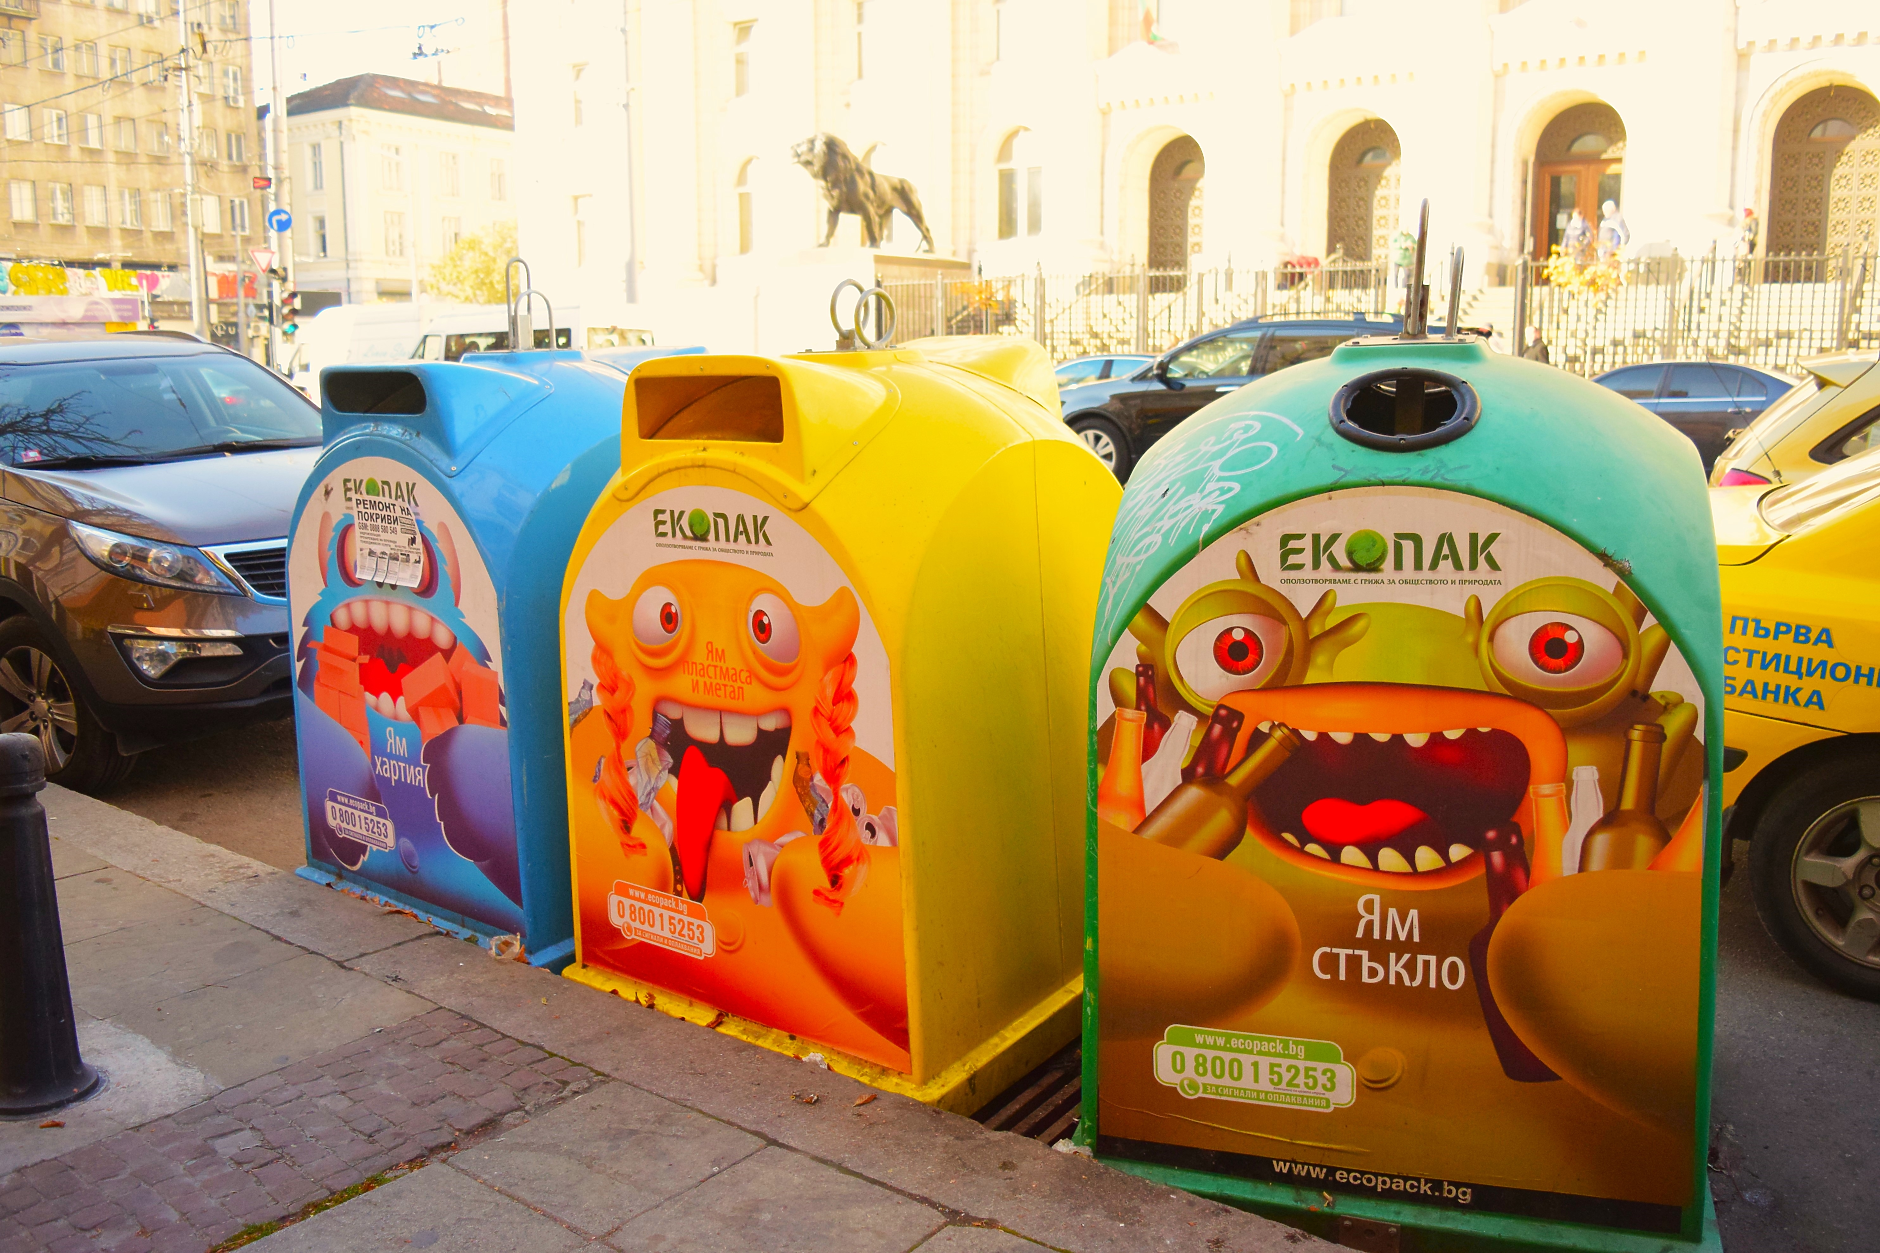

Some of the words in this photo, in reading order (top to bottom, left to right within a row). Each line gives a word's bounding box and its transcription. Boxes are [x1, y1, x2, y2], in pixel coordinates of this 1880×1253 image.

[355, 498, 397, 514] РЕМОНТ
[399, 505, 413, 517] НА
[357, 510, 399, 526] ПОКРИВИ
[653, 508, 773, 546] ЕКОПАК
[1279, 529, 1502, 571] ЕКОПАК
[1280, 578, 1352, 586] ОПОЛЗОТВОРЯВАМЕ
[1729, 616, 1834, 649] ПЪРВА
[706, 641, 726, 664] Ям
[1723, 646, 1880, 687] СТИЦИОН
[682, 660, 753, 685] пластмаса
[691, 678, 699, 694] и
[703, 680, 744, 702] метал
[1723, 676, 1825, 711] БАНКА
[386, 727, 408, 758] Ям
[374, 755, 424, 788] хартия
[336, 794, 377, 816] www.ecopack.bg
[628, 887, 688, 915] www.ecopack.bg
[1355, 893, 1420, 942] Ям
[1312, 946, 1466, 990] стъкло
[1194, 1033, 1305, 1059] www.ecopack.bg
[1206, 1085, 1217, 1094] ЗА
[1218, 1087, 1257, 1099] СИГНАЛИ
[1259, 1091, 1265, 1100] И
[1267, 1093, 1327, 1107] ОПЛАКВАНИЯ
[1272, 1159, 1472, 1204] www.ecopack.bg
